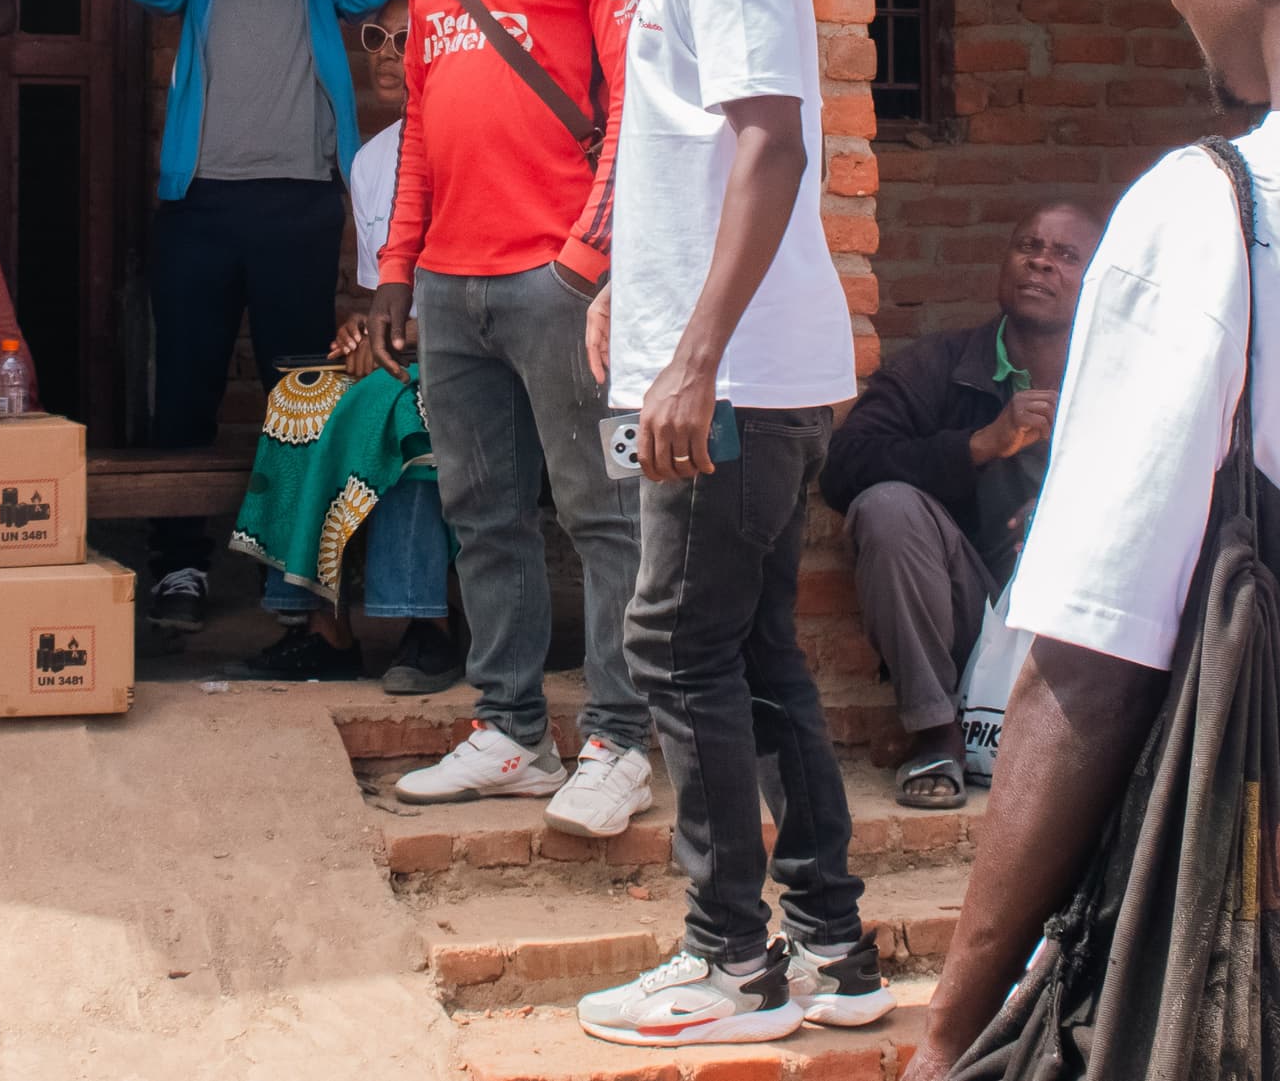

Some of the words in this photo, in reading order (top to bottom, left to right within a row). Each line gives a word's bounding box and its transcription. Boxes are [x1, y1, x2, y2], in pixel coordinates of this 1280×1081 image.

[1, 531, 19, 542] UN
[22, 530, 48, 541] 3481
[38, 676, 55, 686] UN
[58, 675, 83, 686] 3481
